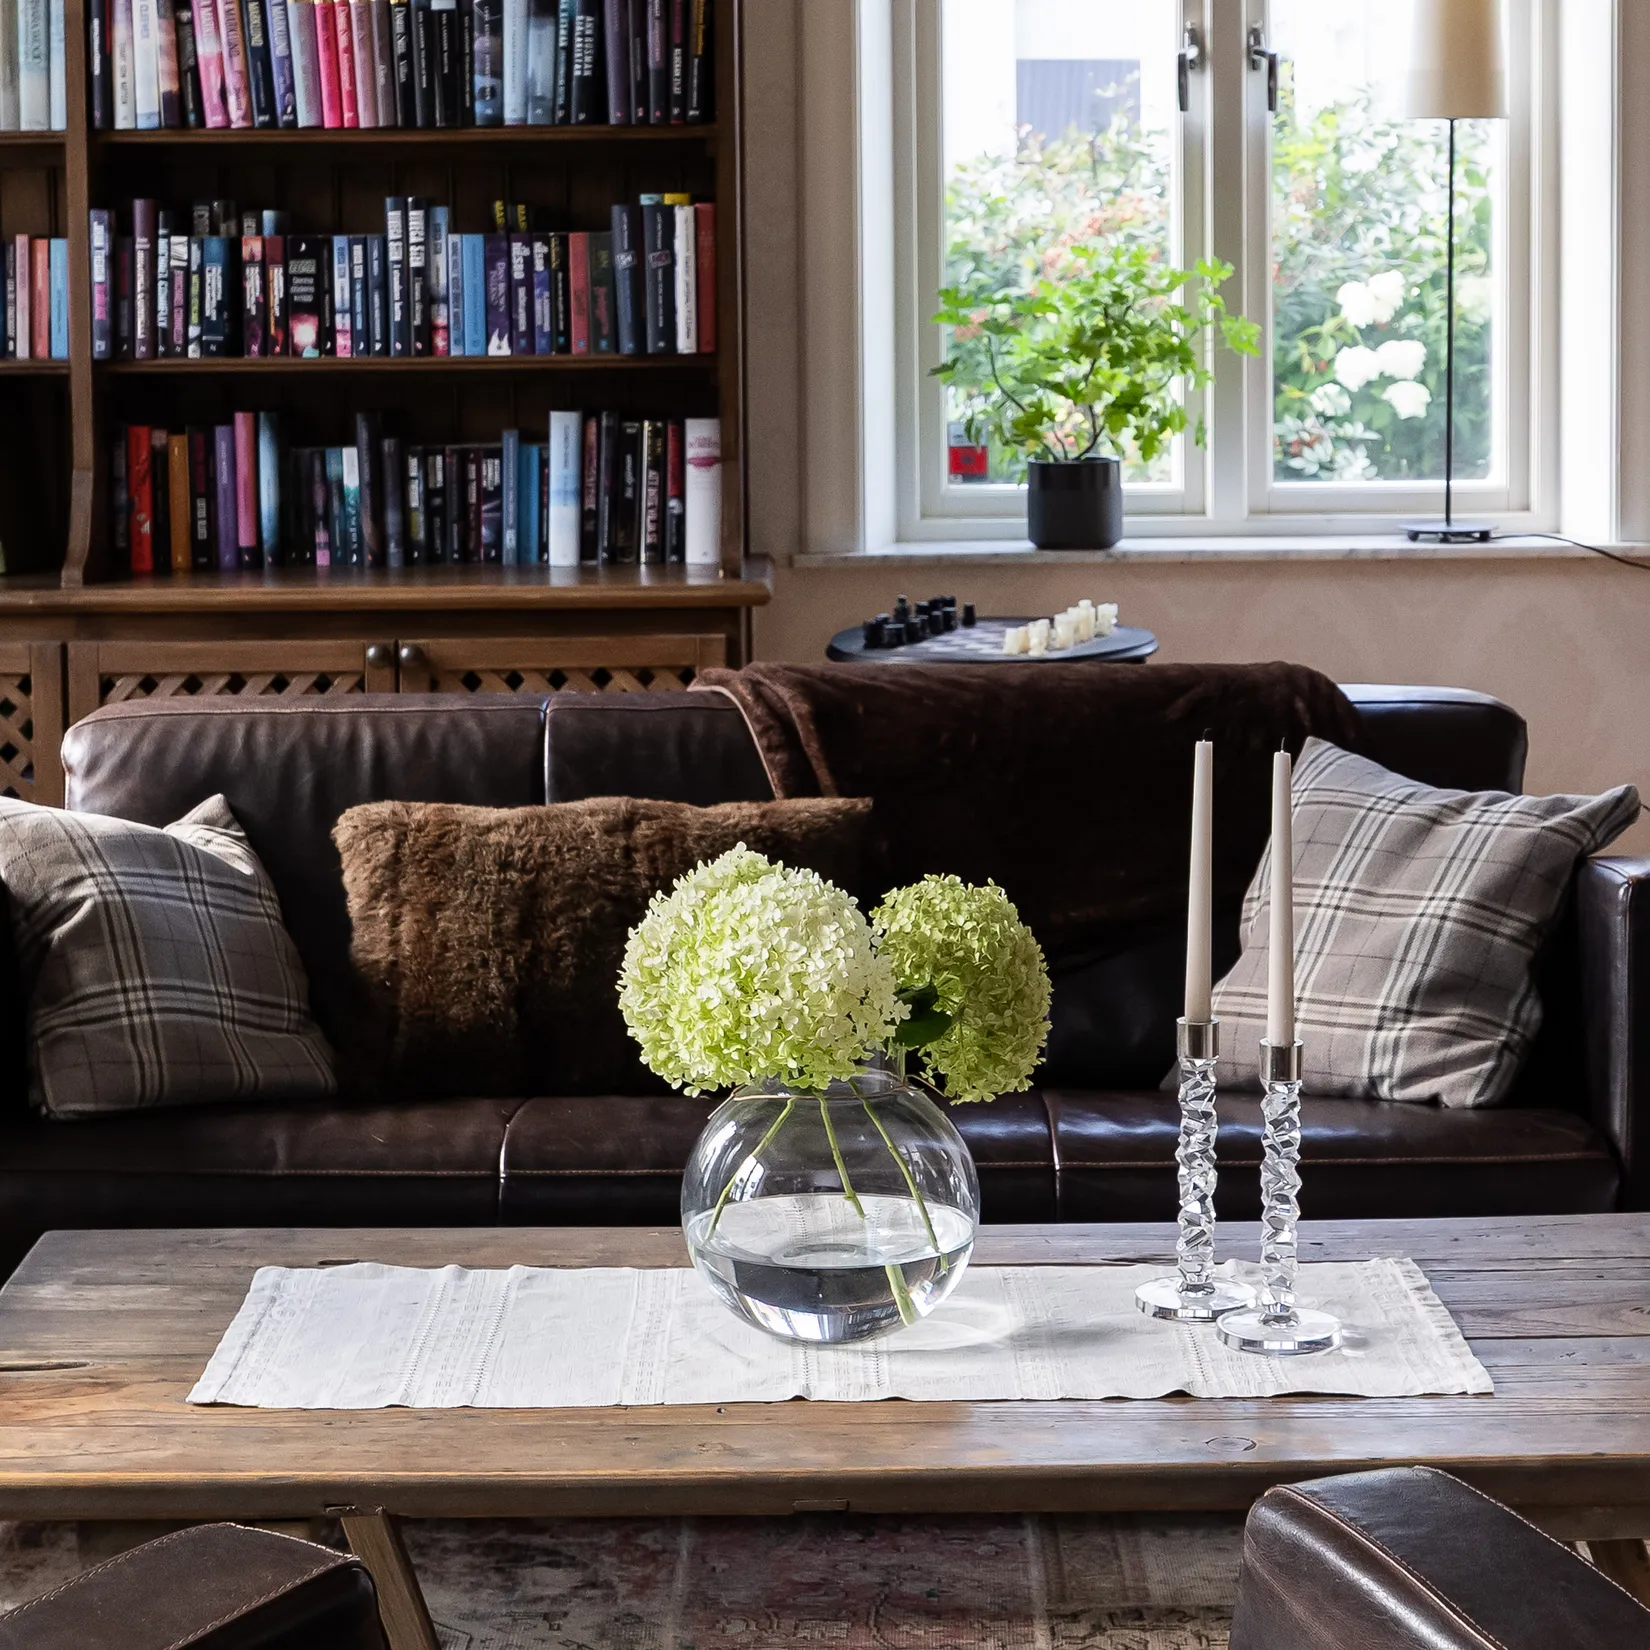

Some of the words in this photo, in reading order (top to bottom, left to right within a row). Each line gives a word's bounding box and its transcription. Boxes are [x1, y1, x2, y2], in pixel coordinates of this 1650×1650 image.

[248, 2, 264, 46] MARKLUND
[585, 15, 595, 35] ANN
[584, 36, 594, 76] ROSMAN
